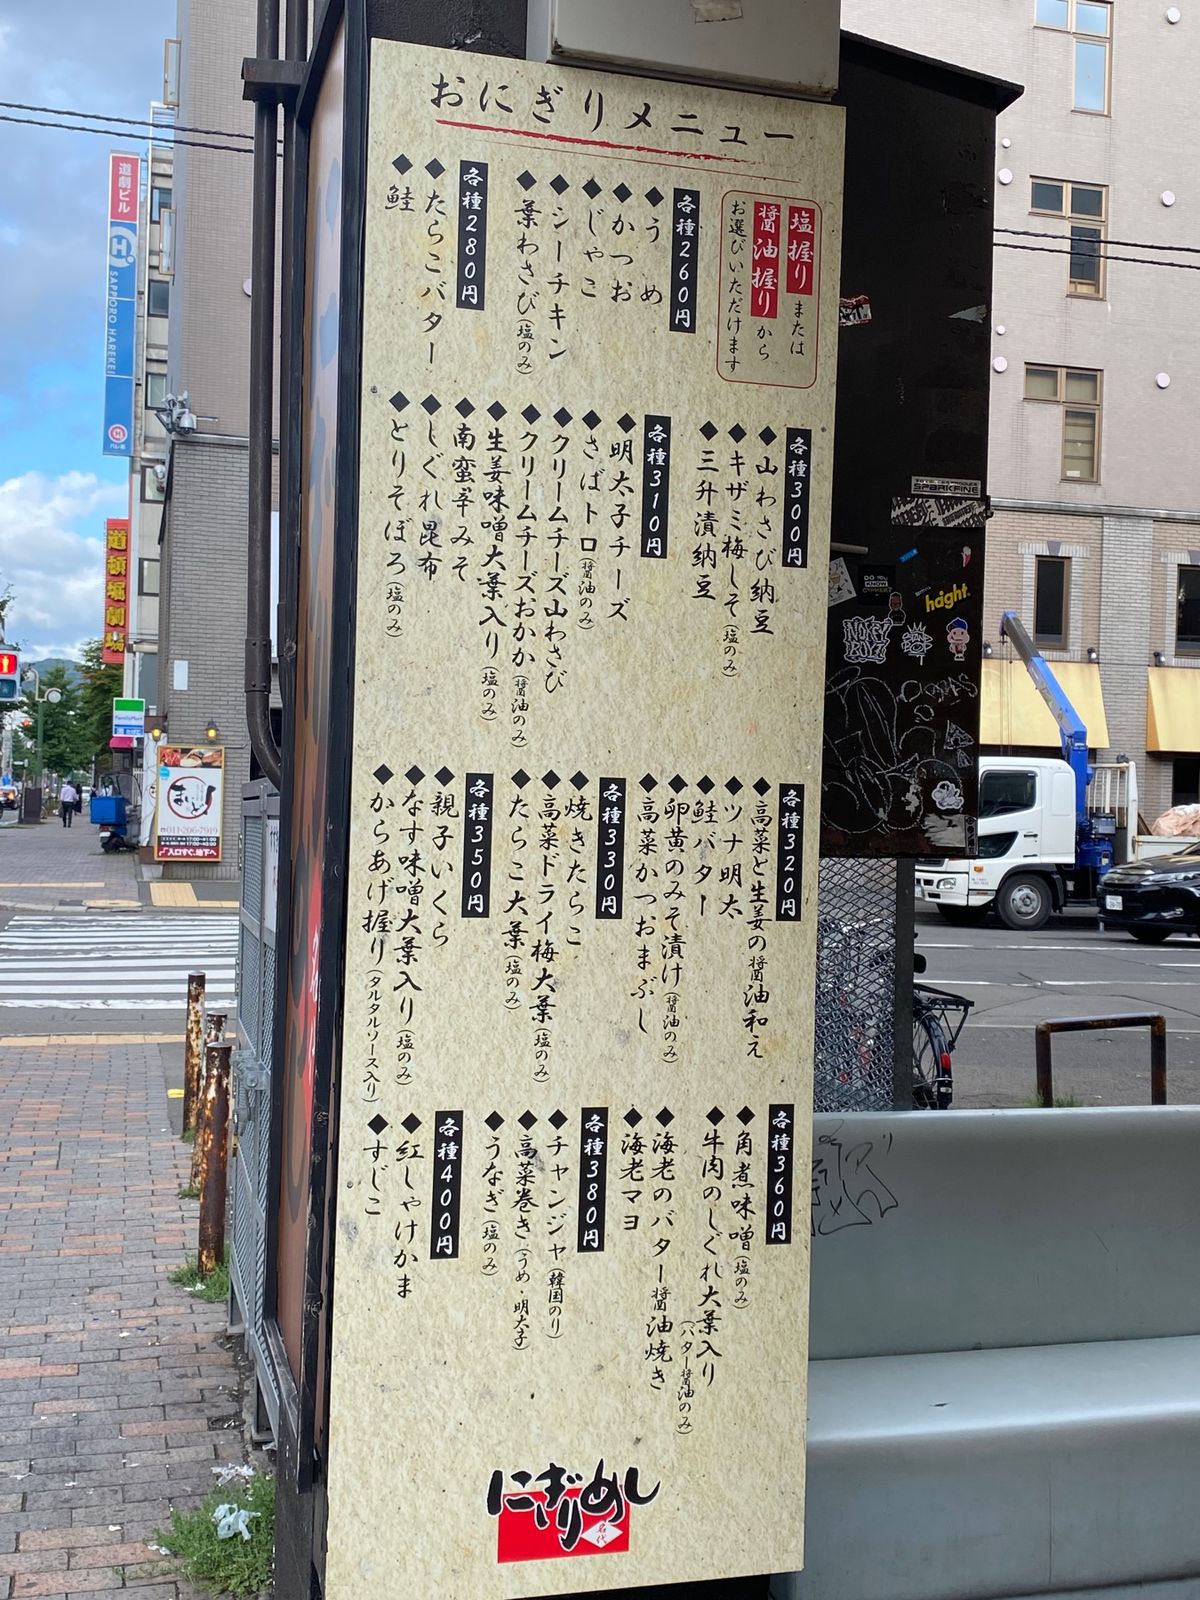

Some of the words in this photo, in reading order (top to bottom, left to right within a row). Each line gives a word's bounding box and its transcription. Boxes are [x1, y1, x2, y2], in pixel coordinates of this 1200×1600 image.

[429, 72, 796, 146] おにぎりメニュー
[384, 184, 415, 212] 鮭
[460, 166, 484, 305] 各種280円
[580, 208, 605, 298] じゃこ
[609, 213, 635, 303] かつお
[639, 216, 663, 305] うめ
[674, 194, 697, 328] 各種260円
[108, 270, 119, 324] SAPPORO
[421, 189, 447, 364] たらこバター
[547, 206, 570, 360] シーチキン
[724, 199, 748, 373] お選びいただけます
[417, 420, 443, 581] しぐれ昆布
[450, 422, 477, 582] 南蛮辛みそ
[607, 439, 635, 621] 明太子チーズ
[645, 423, 668, 557] 各種310円
[691, 450, 720, 601] 三升漬納豆
[749, 455, 780, 635] 山わさび納豆
[786, 436, 808, 566] 各種300円
[543, 434, 570, 694] クリームチーズ山わさび
[430, 791, 460, 947] 親子いくら
[466, 778, 490, 914] 各種350円
[564, 794, 594, 946] 焼きたらこ
[600, 783, 623, 915] 各種330円
[690, 799, 719, 917] 鮭バター
[718, 804, 744, 920] ツナ明太
[780, 789, 801, 917] 各種320円
[630, 796, 660, 1034] 高菜かつおまぶし
[742, 800, 773, 1059] 高菜と生姜の醤油和え
[362, 1139, 389, 1215] すじこ
[393, 1140, 425, 1299] 紅しゃけかま
[435, 1117, 460, 1255] 各種400円
[581, 1113, 605, 1249] 各種380円
[619, 1131, 648, 1231] 海老マヨ
[770, 1110, 791, 1241] 各種360円
[644, 1131, 679, 1391] 海老のバター醤油焼き
[695, 1128, 725, 1387] 牛肉のしぐれ大葉入り
[486, 1458, 661, 1550] にぎりめし
